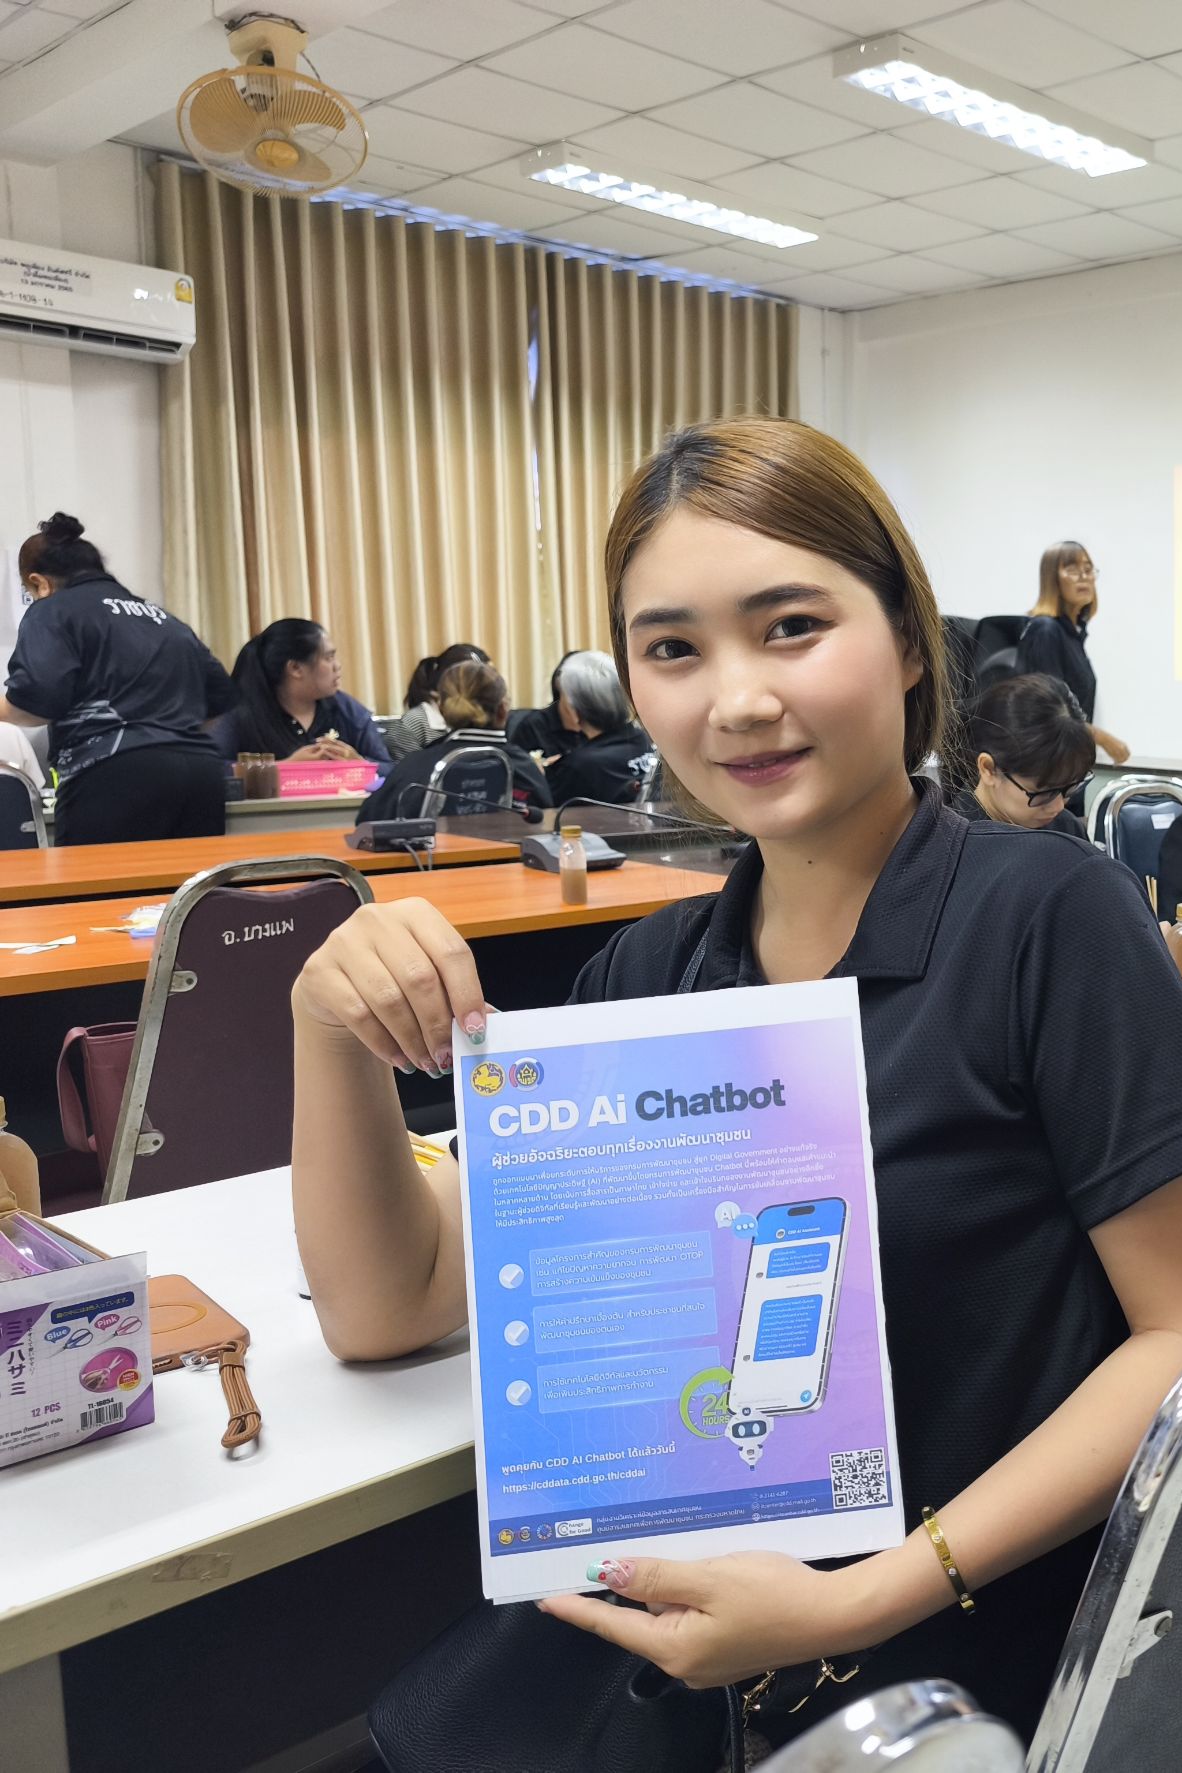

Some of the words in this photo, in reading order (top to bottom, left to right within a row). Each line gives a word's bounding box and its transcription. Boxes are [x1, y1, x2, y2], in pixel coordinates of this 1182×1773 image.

[489, 1099, 579, 1137] CDD
[587, 1093, 627, 1128] Ai
[635, 1079, 786, 1121] Chatbot
[492, 1128, 752, 1169] ผู้ช่วยอัจฉริยะตอบทุกเรื่องงานพัฒนาชุมชน
[709, 1151, 732, 1162] Digital
[733, 1146, 777, 1158] Government
[714, 1161, 743, 1171] Chatbot
[680, 1250, 703, 1260] OTOP
[97, 1315, 118, 1328] Pink
[47, 1328, 67, 1340] Blue
[7, 1320, 26, 1396] ミニハサミ
[31, 1407, 41, 1418] 12
[44, 1402, 62, 1415] PCS
[702, 1391, 729, 1416] 24
[702, 1416, 730, 1427] HOURS
[501, 1460, 543, 1475] พูดคุยกับ
[545, 1457, 569, 1468] CDD
[571, 1455, 582, 1465] AI
[585, 1450, 624, 1463] Chatbot
[627, 1441, 675, 1458] ได้แล้ววันนี้
[502, 1467, 646, 1495] https://cddata.cdd.go.th/cddai
